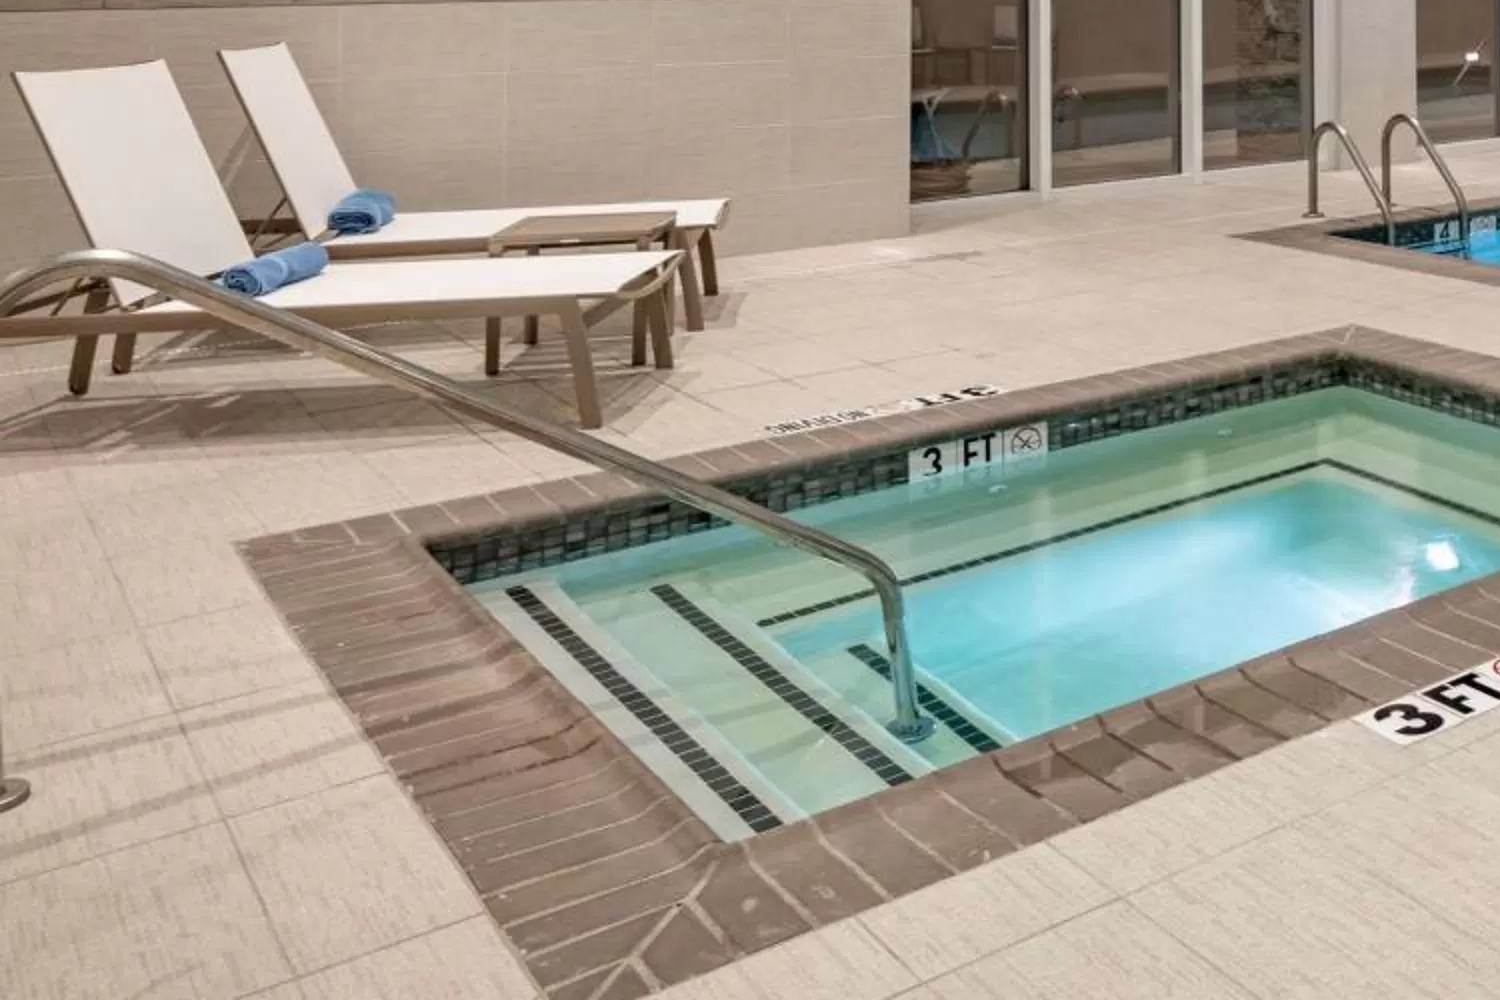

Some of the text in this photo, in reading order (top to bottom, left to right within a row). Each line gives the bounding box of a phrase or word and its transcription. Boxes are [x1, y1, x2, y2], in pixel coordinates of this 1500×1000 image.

[923, 432, 996, 476] 3 FT
[1373, 703, 1445, 735] 3
